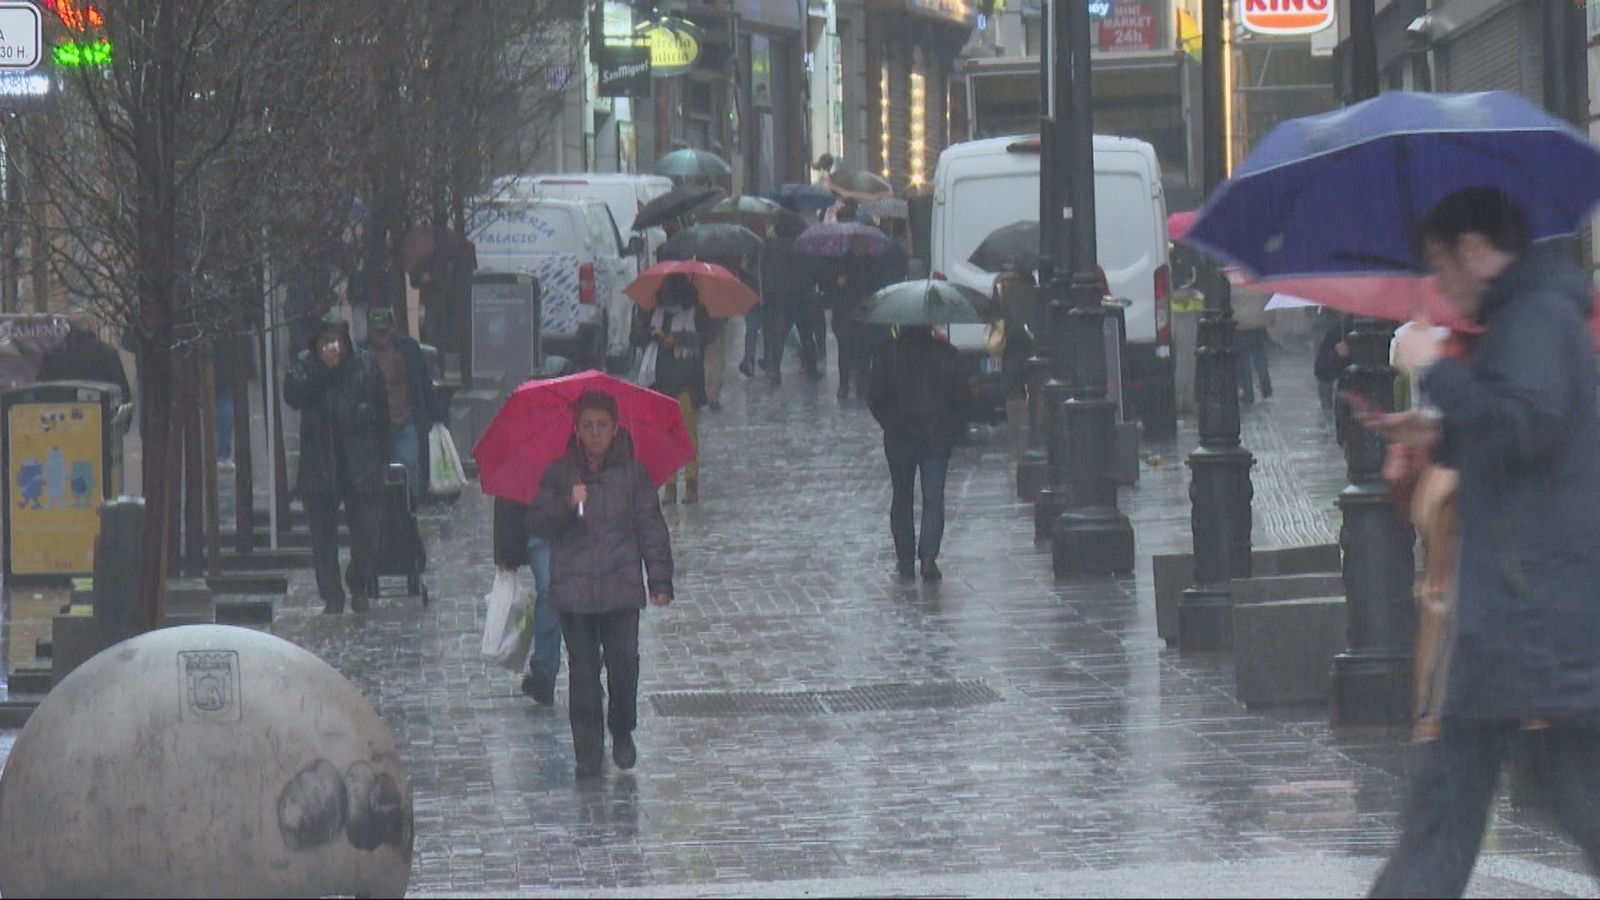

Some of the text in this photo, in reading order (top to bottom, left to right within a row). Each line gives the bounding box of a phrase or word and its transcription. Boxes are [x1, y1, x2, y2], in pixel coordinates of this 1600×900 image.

[1103, 16, 1152, 28] MARKET
[1115, 29, 1142, 43] 24h
[478, 232, 537, 245] PALACIO
